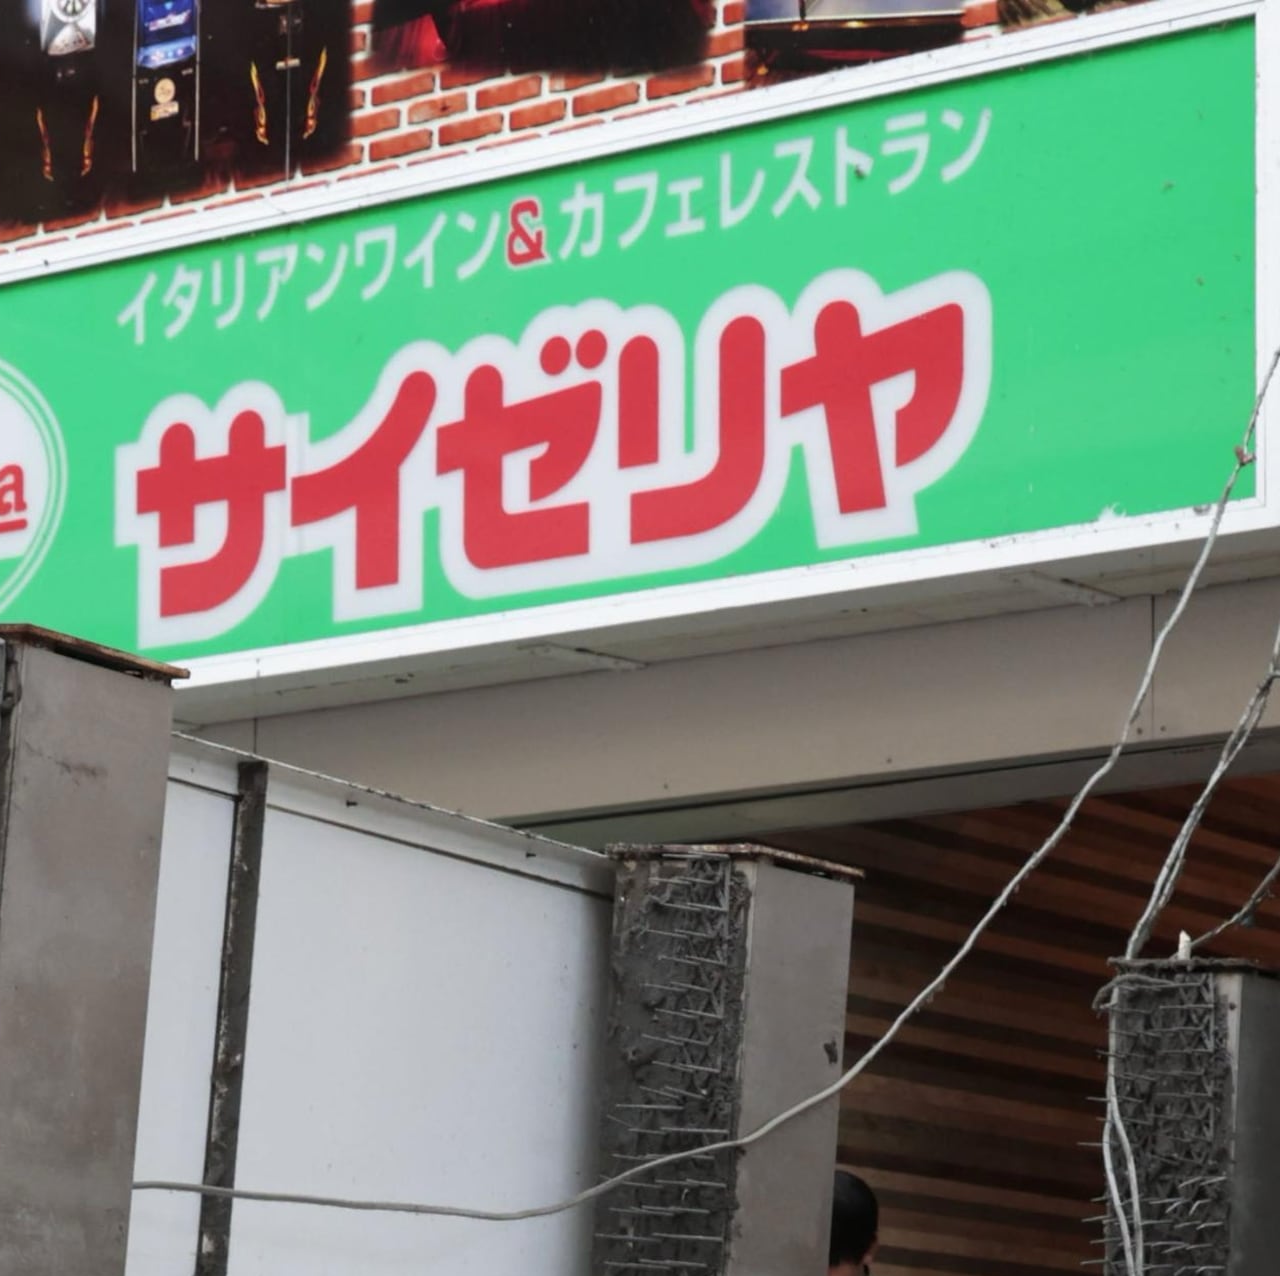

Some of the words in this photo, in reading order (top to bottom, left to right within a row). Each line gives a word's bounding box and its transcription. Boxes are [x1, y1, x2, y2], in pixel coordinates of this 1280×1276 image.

[130, 296, 970, 622] サイゼリヤ
